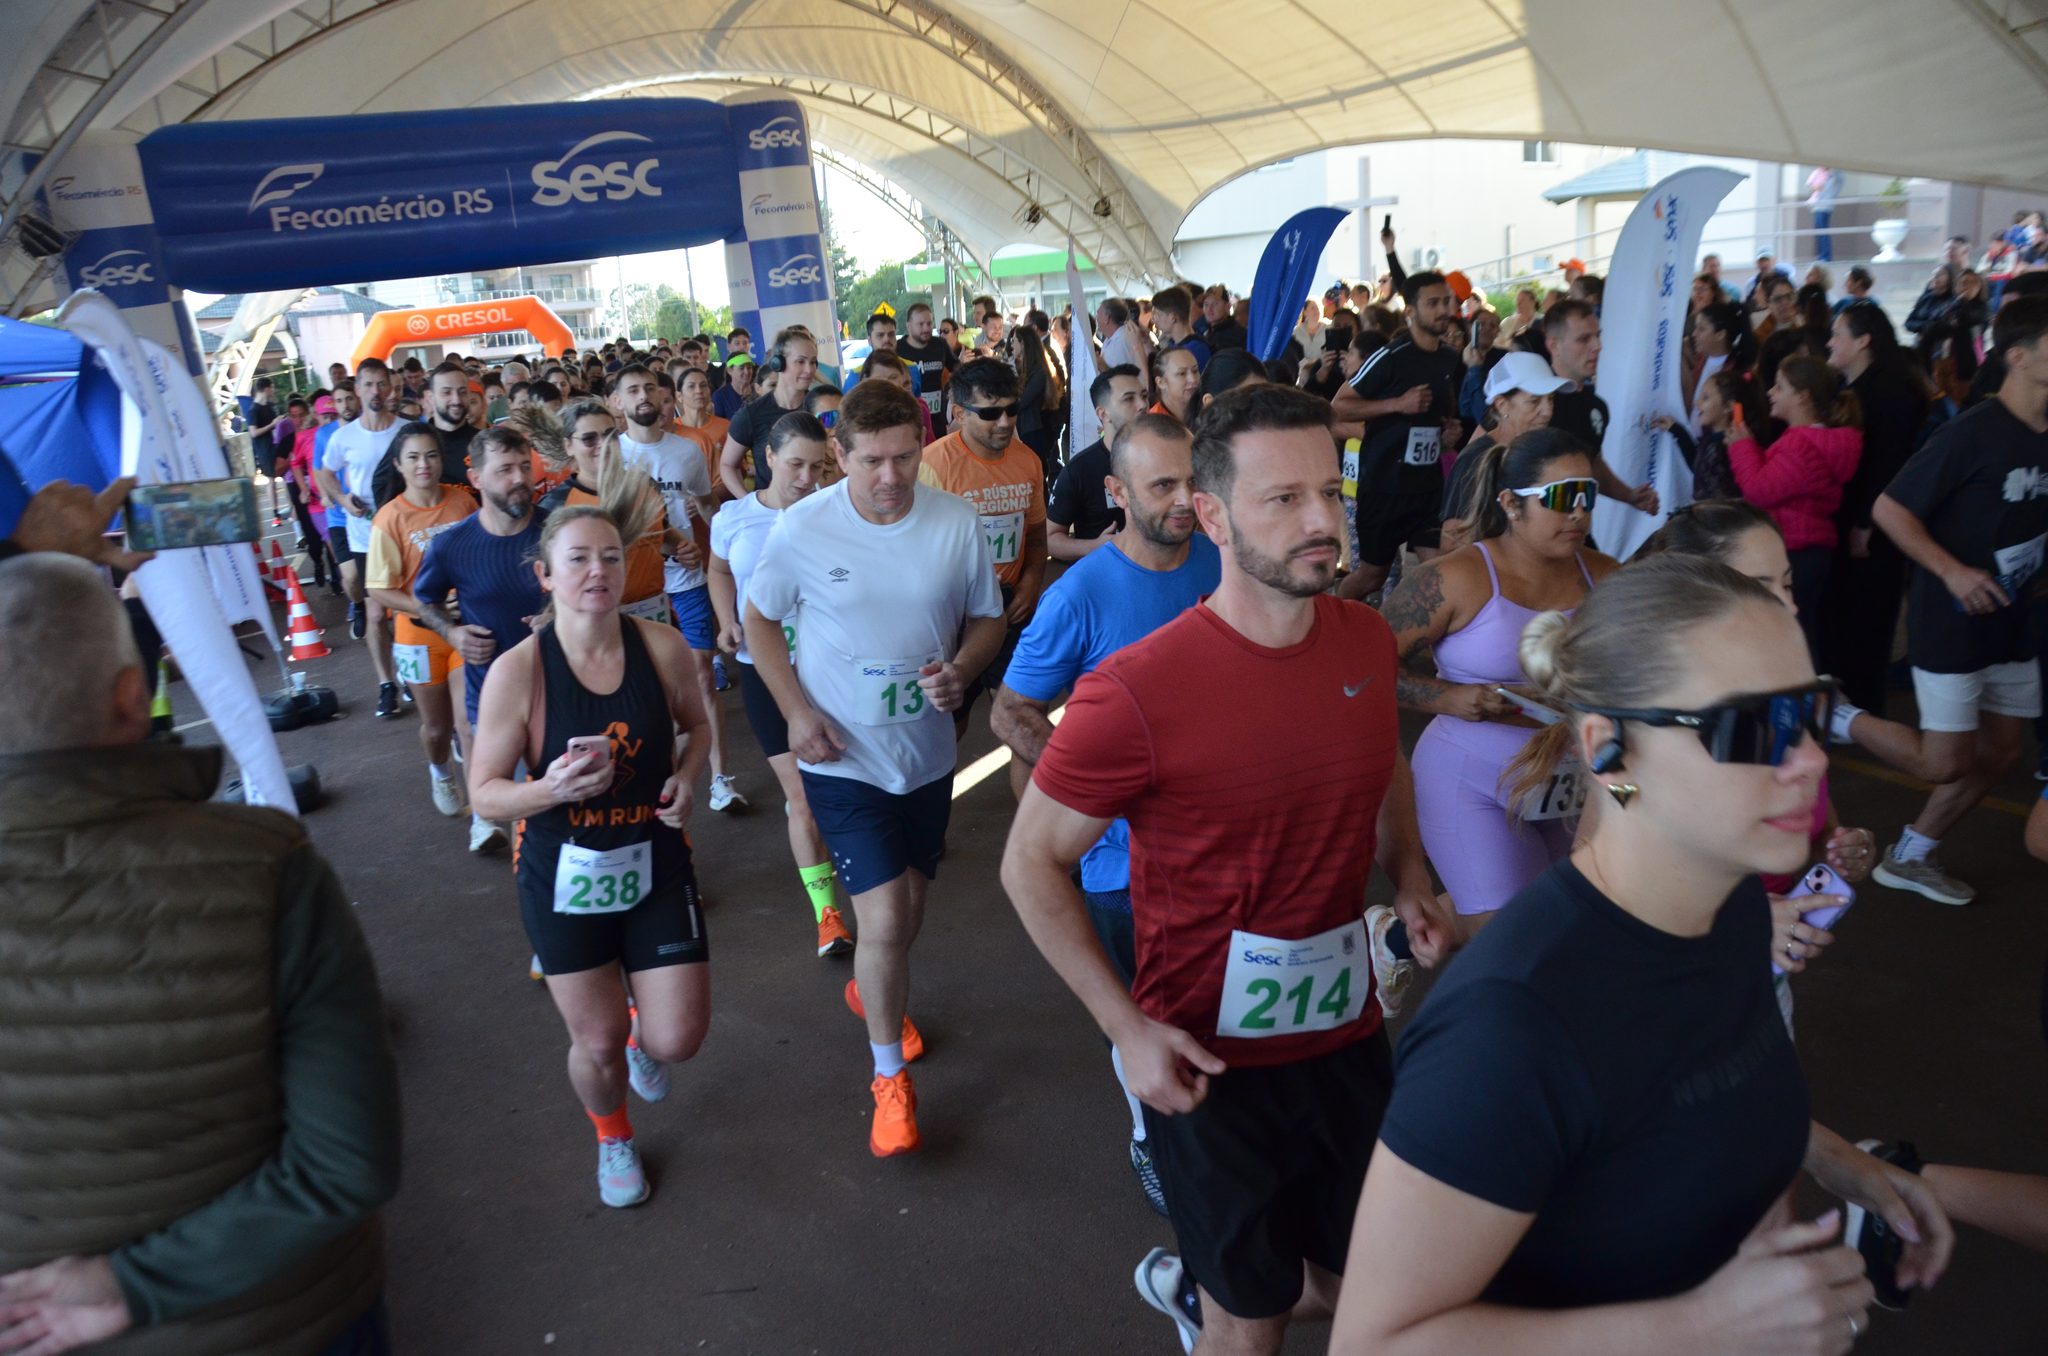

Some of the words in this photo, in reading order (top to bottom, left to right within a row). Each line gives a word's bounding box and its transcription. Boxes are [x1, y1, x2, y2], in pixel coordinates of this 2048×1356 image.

[748, 122, 802, 150] Sesc
[531, 145, 663, 206] Sesc
[269, 195, 446, 233] Fecomércio
[453, 188, 494, 217] RS
[754, 202, 805, 215] Fecomércio
[80, 256, 155, 288] Sesc
[768, 259, 822, 287] Sesc
[434, 307, 513, 330] CRESOL
[1412, 441, 1438, 462] 516
[986, 531, 1017, 559] 11
[863, 666, 887, 676] Sesc
[881, 680, 924, 717] 13
[568, 806, 604, 828] VM
[610, 804, 655, 827] RUN
[568, 869, 641, 909] 238
[1243, 947, 1283, 967] Sesc
[1238, 966, 1351, 1030] 214
